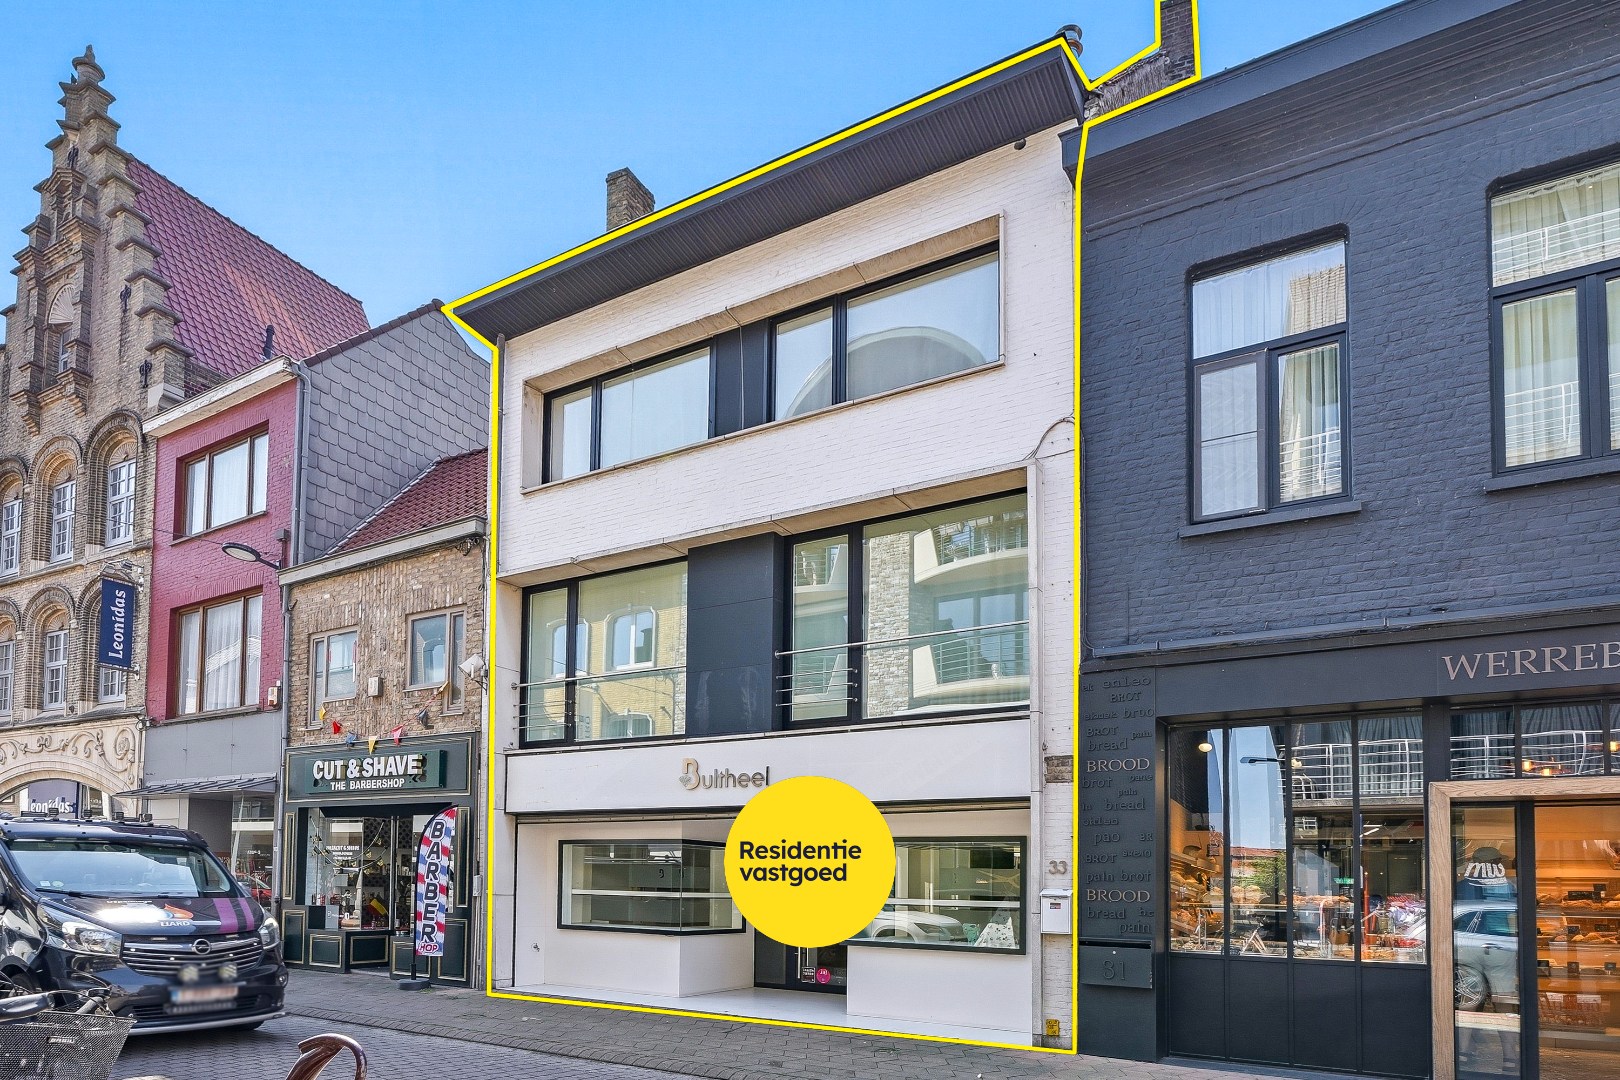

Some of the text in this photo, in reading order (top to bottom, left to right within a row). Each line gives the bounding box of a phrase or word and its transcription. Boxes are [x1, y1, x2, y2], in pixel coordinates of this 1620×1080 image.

[108, 590, 126, 658] Leonidas
[1441, 641, 1620, 680] WERREB
[1086, 726, 1119, 738] BROT
[1087, 738, 1128, 752] bread
[313, 754, 420, 780] CUT & SHAVE
[1086, 757, 1150, 773] BROOD
[679, 758, 769, 790] Bultheel
[331, 778, 405, 791] THE BARBERSHOP
[1104, 797, 1146, 811] bread
[1085, 853, 1118, 864] BROT
[1049, 860, 1068, 875] 33
[421, 820, 445, 943] BARBER
[1085, 869, 1151, 885] pain brot
[1086, 888, 1151, 903] BROOD
[1087, 906, 1126, 919] bread
[1119, 920, 1152, 935] pain
[1103, 959, 1127, 981] 31
